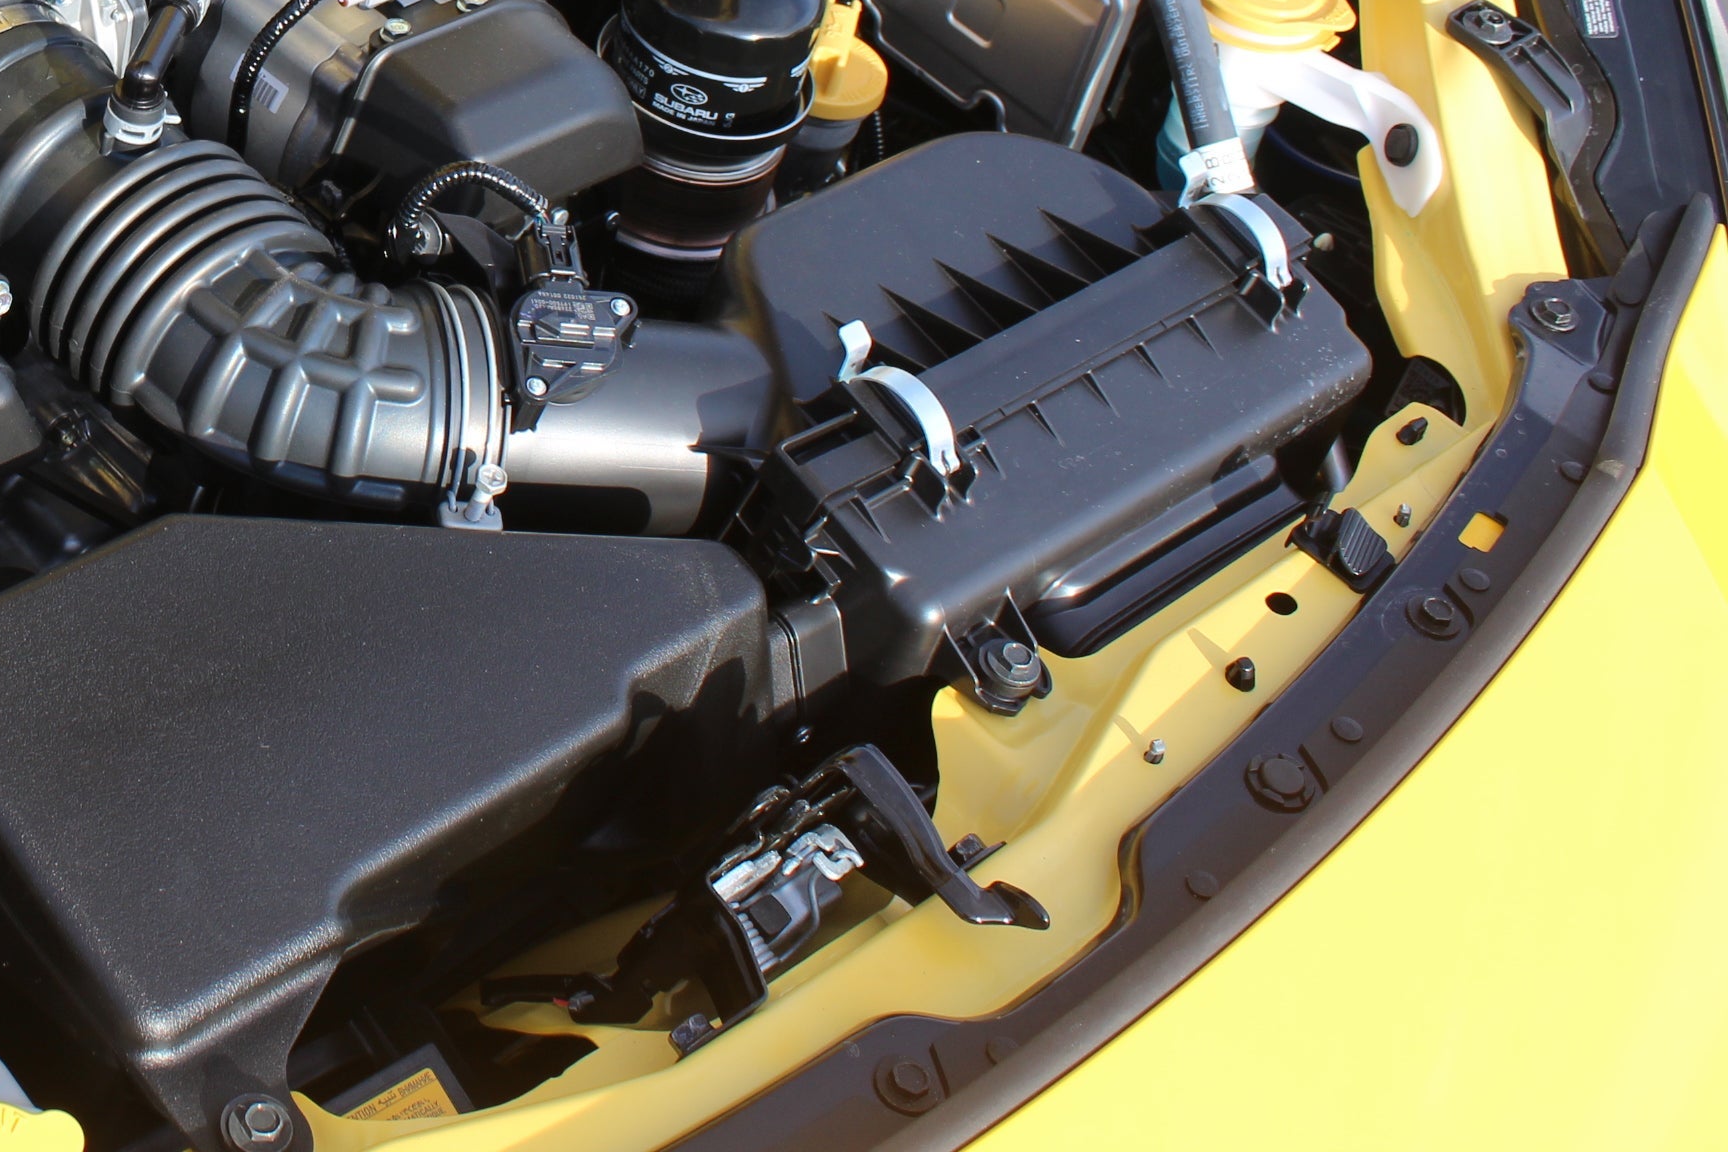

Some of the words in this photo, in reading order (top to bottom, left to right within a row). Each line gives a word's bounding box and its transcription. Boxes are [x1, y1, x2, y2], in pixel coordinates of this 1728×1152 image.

[652, 100, 675, 116] MADE
[676, 112, 687, 120] IN
[653, 92, 719, 120] SUBARU
